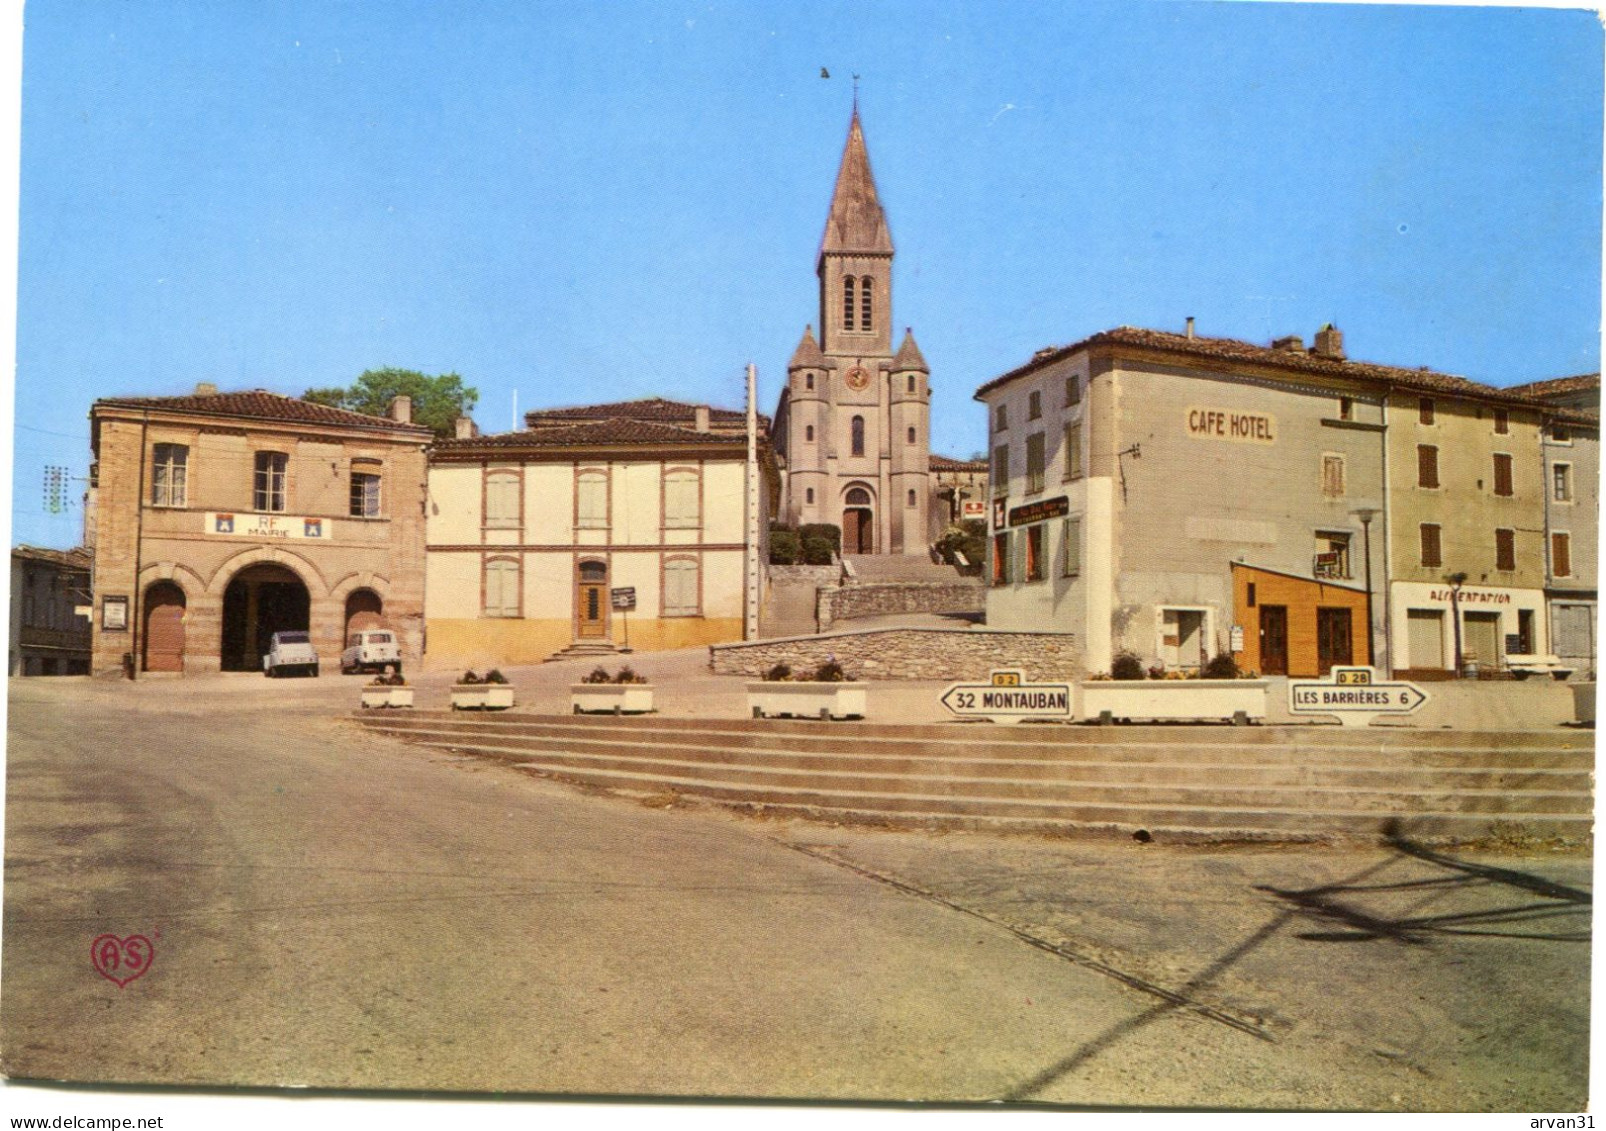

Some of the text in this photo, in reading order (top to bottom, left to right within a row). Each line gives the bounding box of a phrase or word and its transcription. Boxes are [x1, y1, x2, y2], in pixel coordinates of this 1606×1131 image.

[1189, 410, 1273, 440] CAFE HOTEL
[259, 516, 278, 529] RF
[248, 529, 289, 538] MAIRIE
[997, 676, 1015, 685] D 2
[1339, 673, 1368, 683] D 28
[956, 692, 1066, 709] 32 MONTAUBAN
[1297, 689, 1409, 704] LES BARRIÈRES 6
